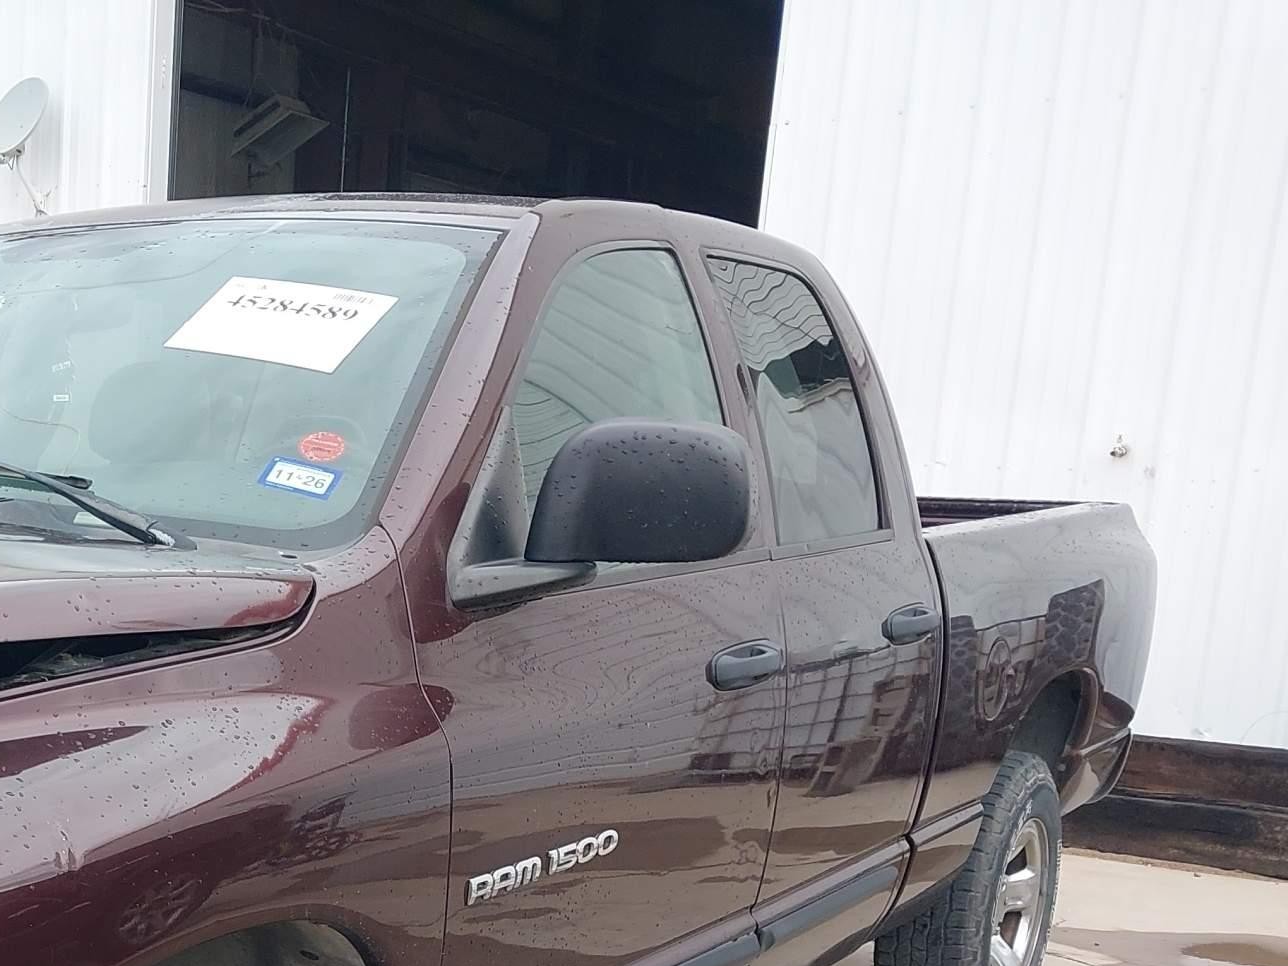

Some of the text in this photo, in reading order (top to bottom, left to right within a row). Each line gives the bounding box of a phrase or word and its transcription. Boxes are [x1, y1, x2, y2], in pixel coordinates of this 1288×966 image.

[227, 294, 359, 320] 45284589
[466, 829, 619, 906] RAM 1500
